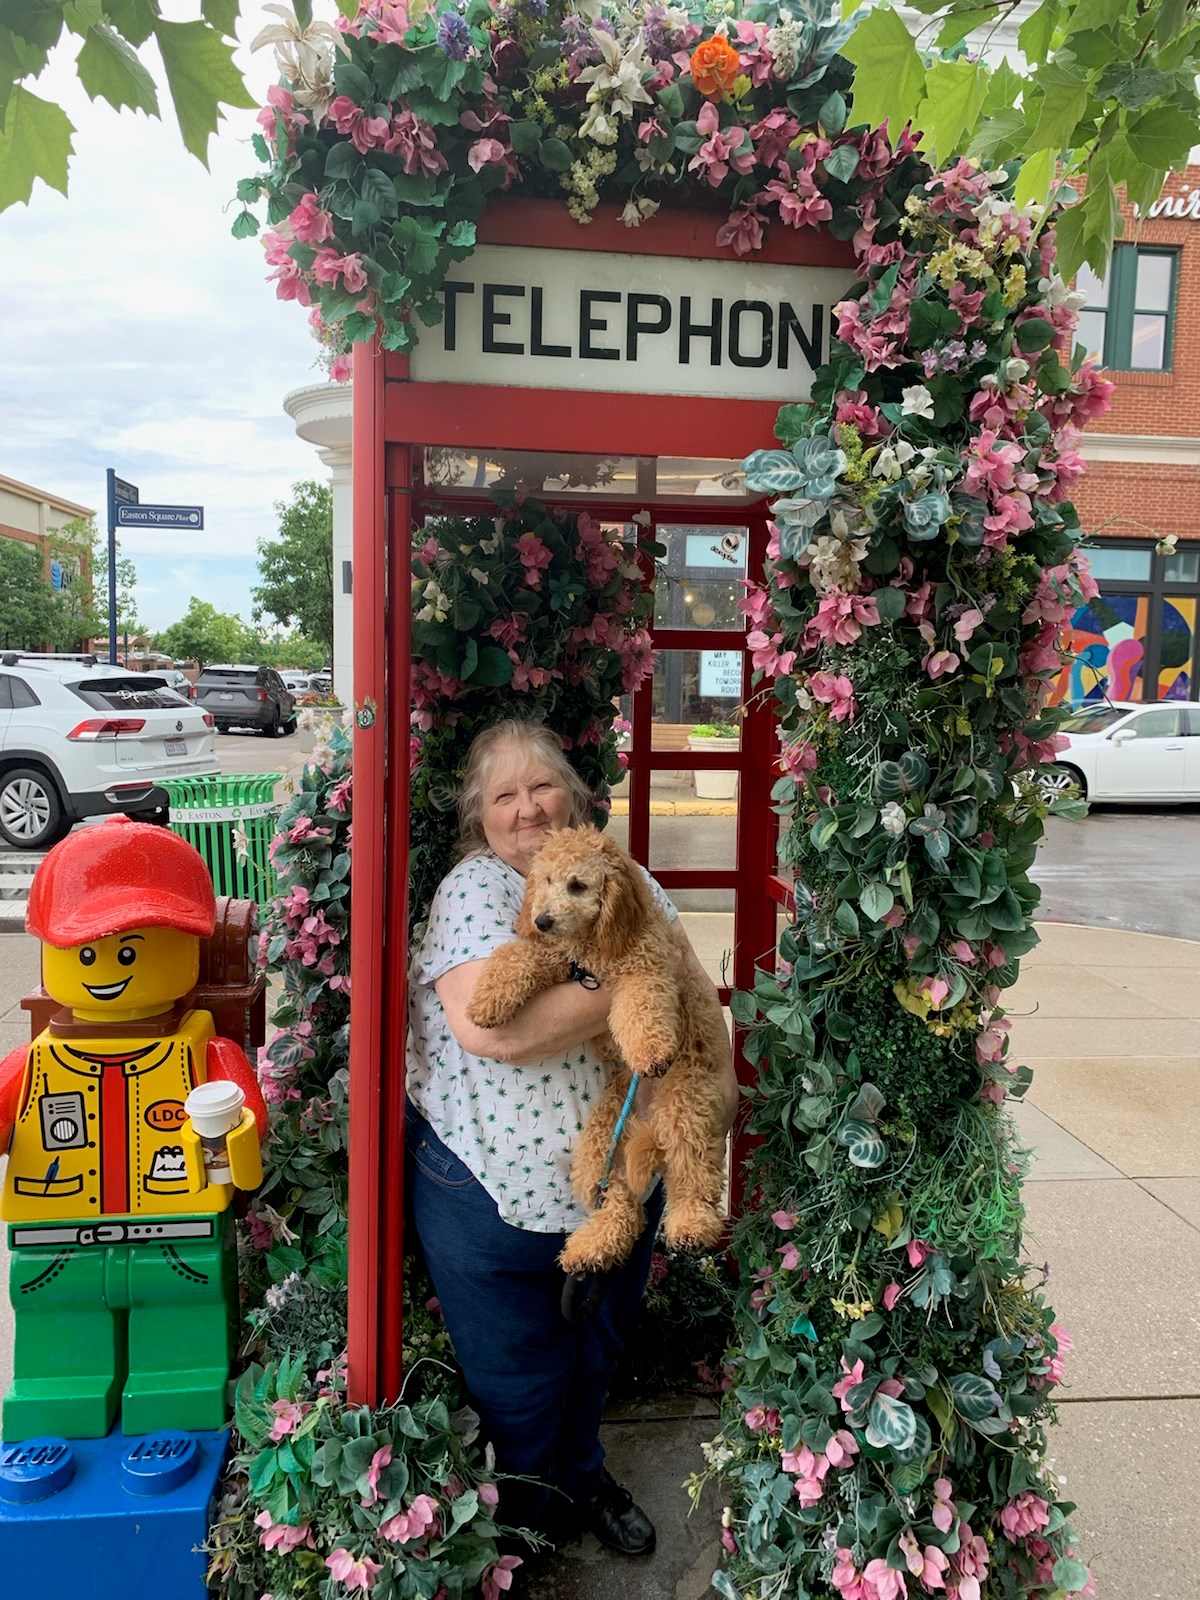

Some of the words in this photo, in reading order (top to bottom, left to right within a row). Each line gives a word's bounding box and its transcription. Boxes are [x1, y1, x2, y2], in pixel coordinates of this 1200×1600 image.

[438, 281, 837, 370] TELEPHON
[121, 510, 147, 520] Easton
[148, 511, 175, 522] Square
[363, 710, 369, 724] 8
[188, 812, 222, 820] EASTON
[152, 1109, 185, 1122] LDC
[1, 1445, 66, 1466] LEGO
[128, 1439, 191, 1461] LEGO
